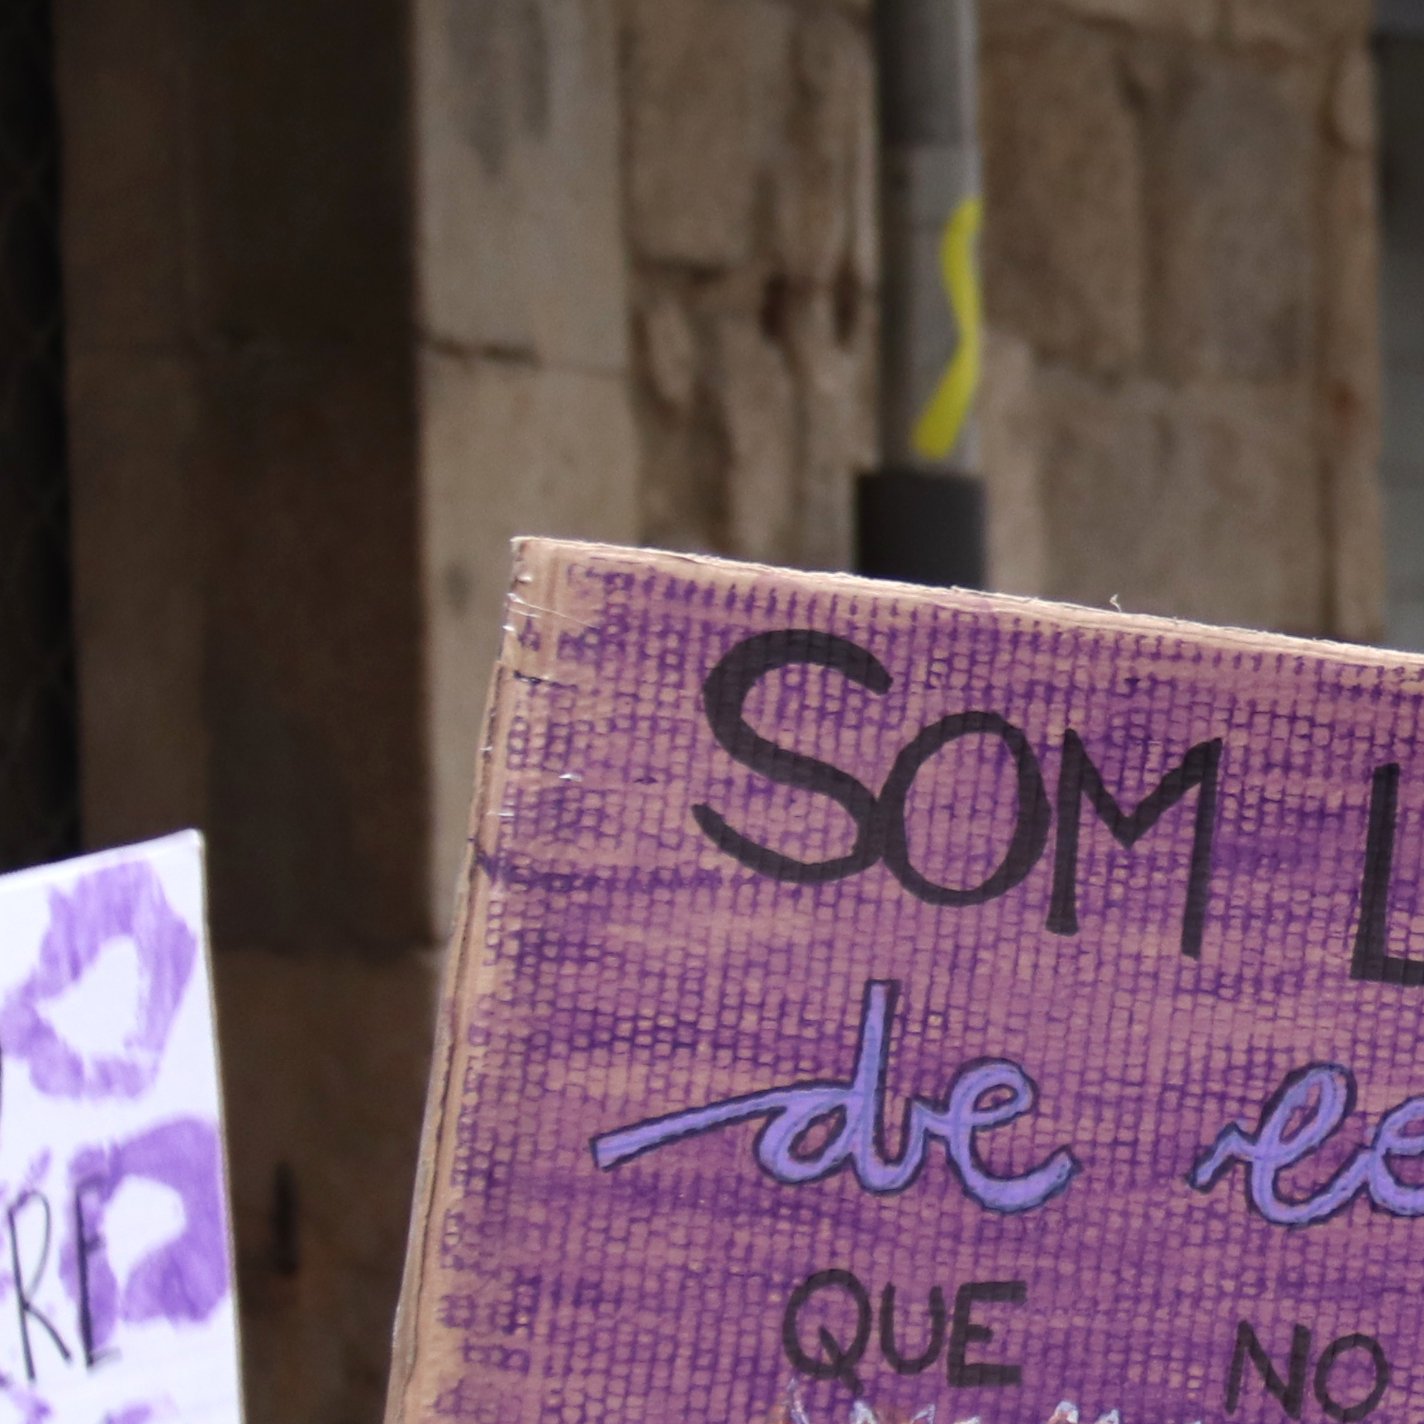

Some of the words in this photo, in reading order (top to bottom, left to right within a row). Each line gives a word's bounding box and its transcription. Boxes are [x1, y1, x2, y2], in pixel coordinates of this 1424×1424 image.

[691, 628, 1223, 958] SOM
[589, 979, 1083, 1212] de
[782, 1268, 1027, 1394] QUE
[1223, 1321, 1392, 1424] NO
